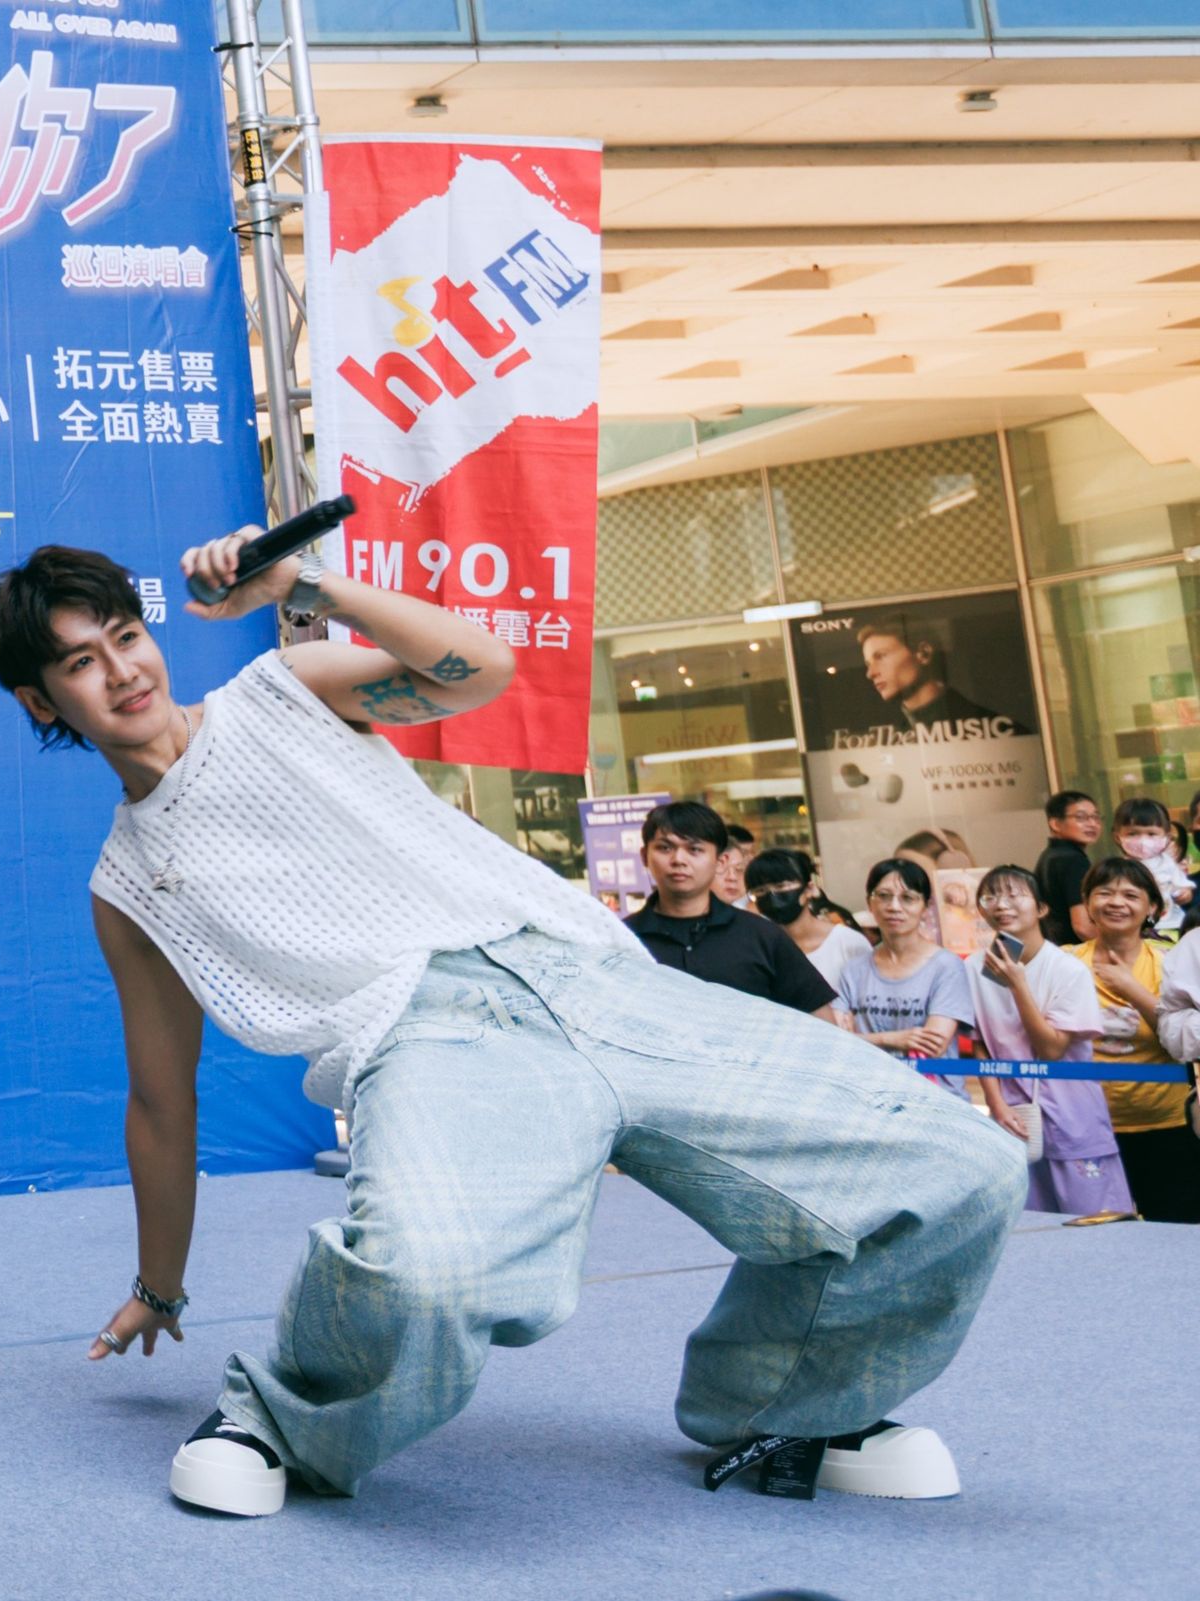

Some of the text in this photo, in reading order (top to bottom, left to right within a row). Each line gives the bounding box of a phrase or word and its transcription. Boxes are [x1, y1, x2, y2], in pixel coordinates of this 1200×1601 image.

[10, 9, 177, 43] ALL OVER AGAIN
[61, 245, 209, 288] 巡迴演唱會
[53, 346, 218, 393] 拓元售票
[336, 274, 518, 434] hit
[57, 401, 224, 445] 全面熱賣
[352, 539, 571, 600] FM 90.1
[801, 618, 854, 634] SONY
